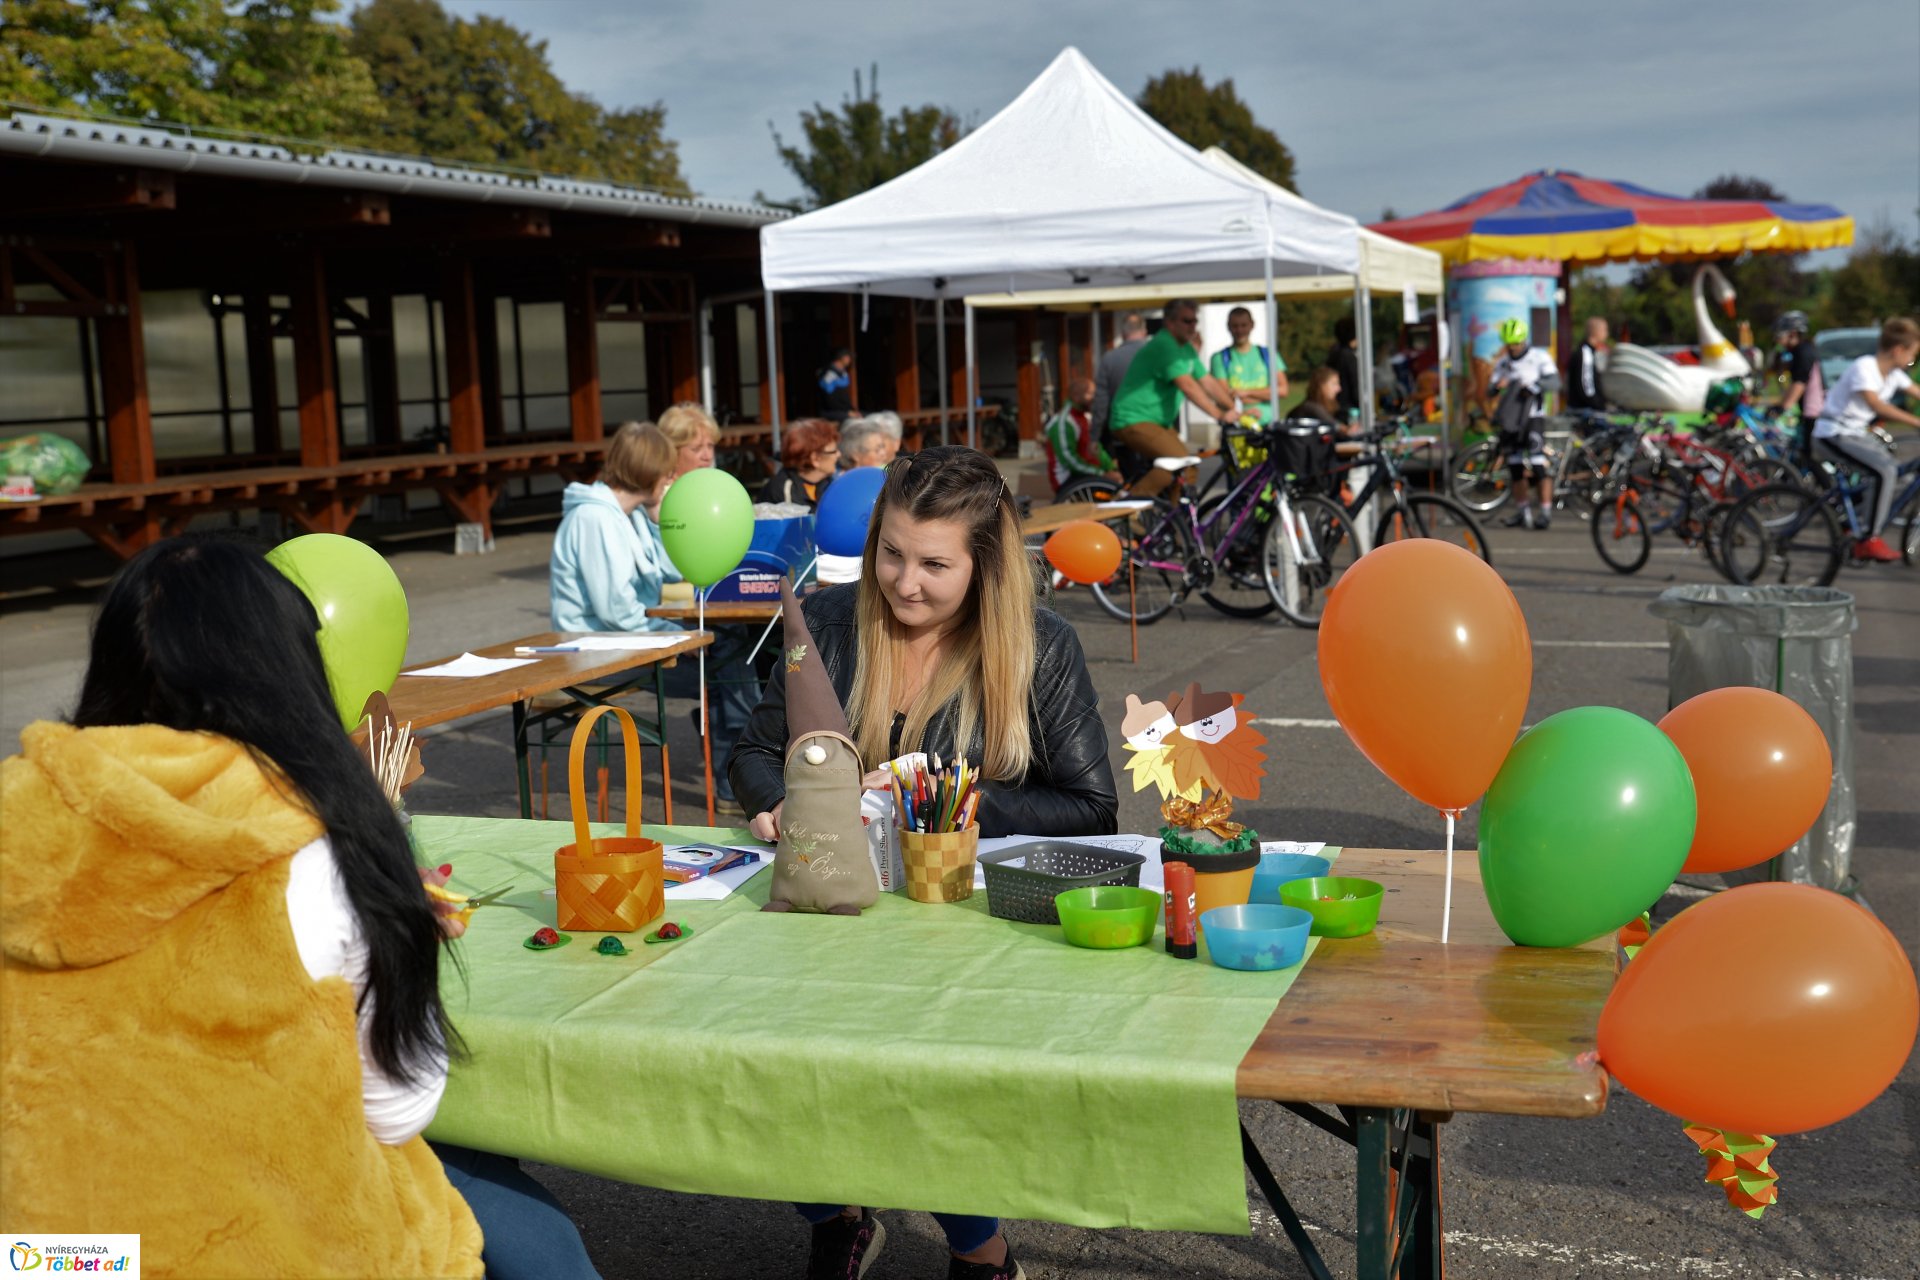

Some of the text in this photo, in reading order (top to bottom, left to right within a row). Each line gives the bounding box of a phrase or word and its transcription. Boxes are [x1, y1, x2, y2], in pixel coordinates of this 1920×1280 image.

[739, 582, 780, 594] ENERGY
[879, 817, 888, 849] Sharpener
[879, 849, 887, 870] Pencil
